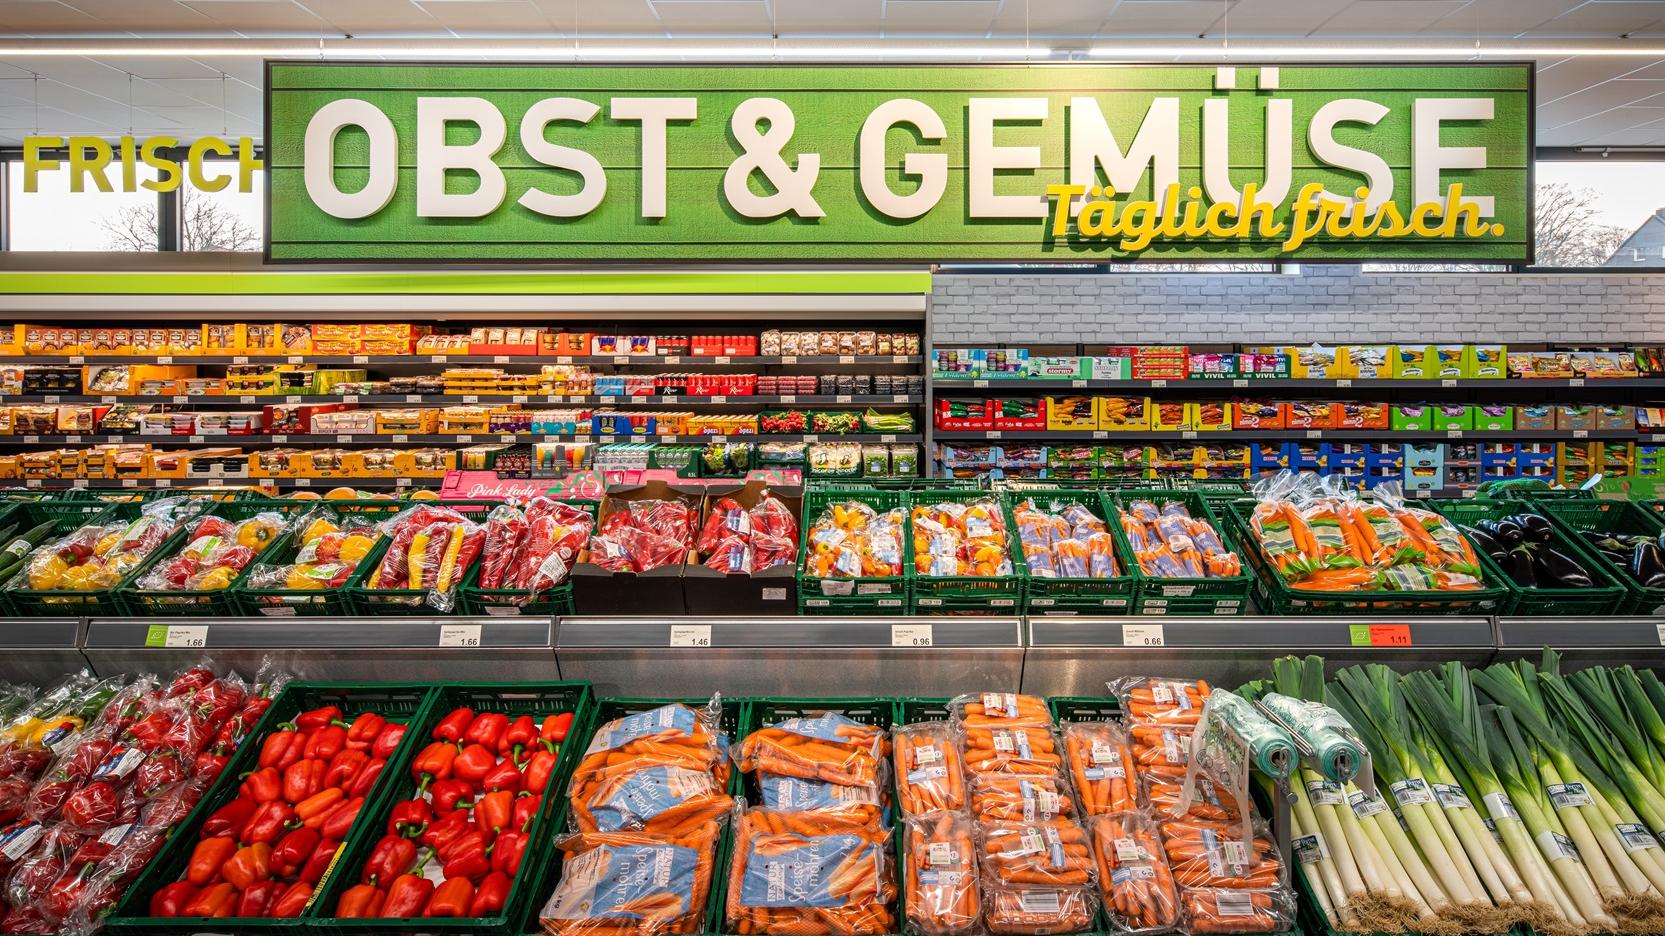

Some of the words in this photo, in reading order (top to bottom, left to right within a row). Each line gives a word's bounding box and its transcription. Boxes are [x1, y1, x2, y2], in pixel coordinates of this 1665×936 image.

[304, 97, 698, 219] OBST
[724, 97, 824, 219] &
[859, 66, 1496, 219] GEMÜSE
[1046, 182, 1283, 252] Täglich
[1282, 182, 1506, 252] frisch.
[703, 425, 719, 434] Spezi
[738, 425, 754, 434] Spezi
[466, 482, 503, 498] Pink
[502, 482, 535, 498] Lady
[461, 638, 478, 646] 1.66
[692, 638, 708, 646] 1.46
[913, 638, 930, 646] 0.96
[1144, 638, 1162, 646] 0.66
[1390, 636, 1407, 644] 1.11
[633, 846, 654, 894] Speise-
[767, 862, 778, 900] NATUR
[788, 852, 808, 903] Speise-
